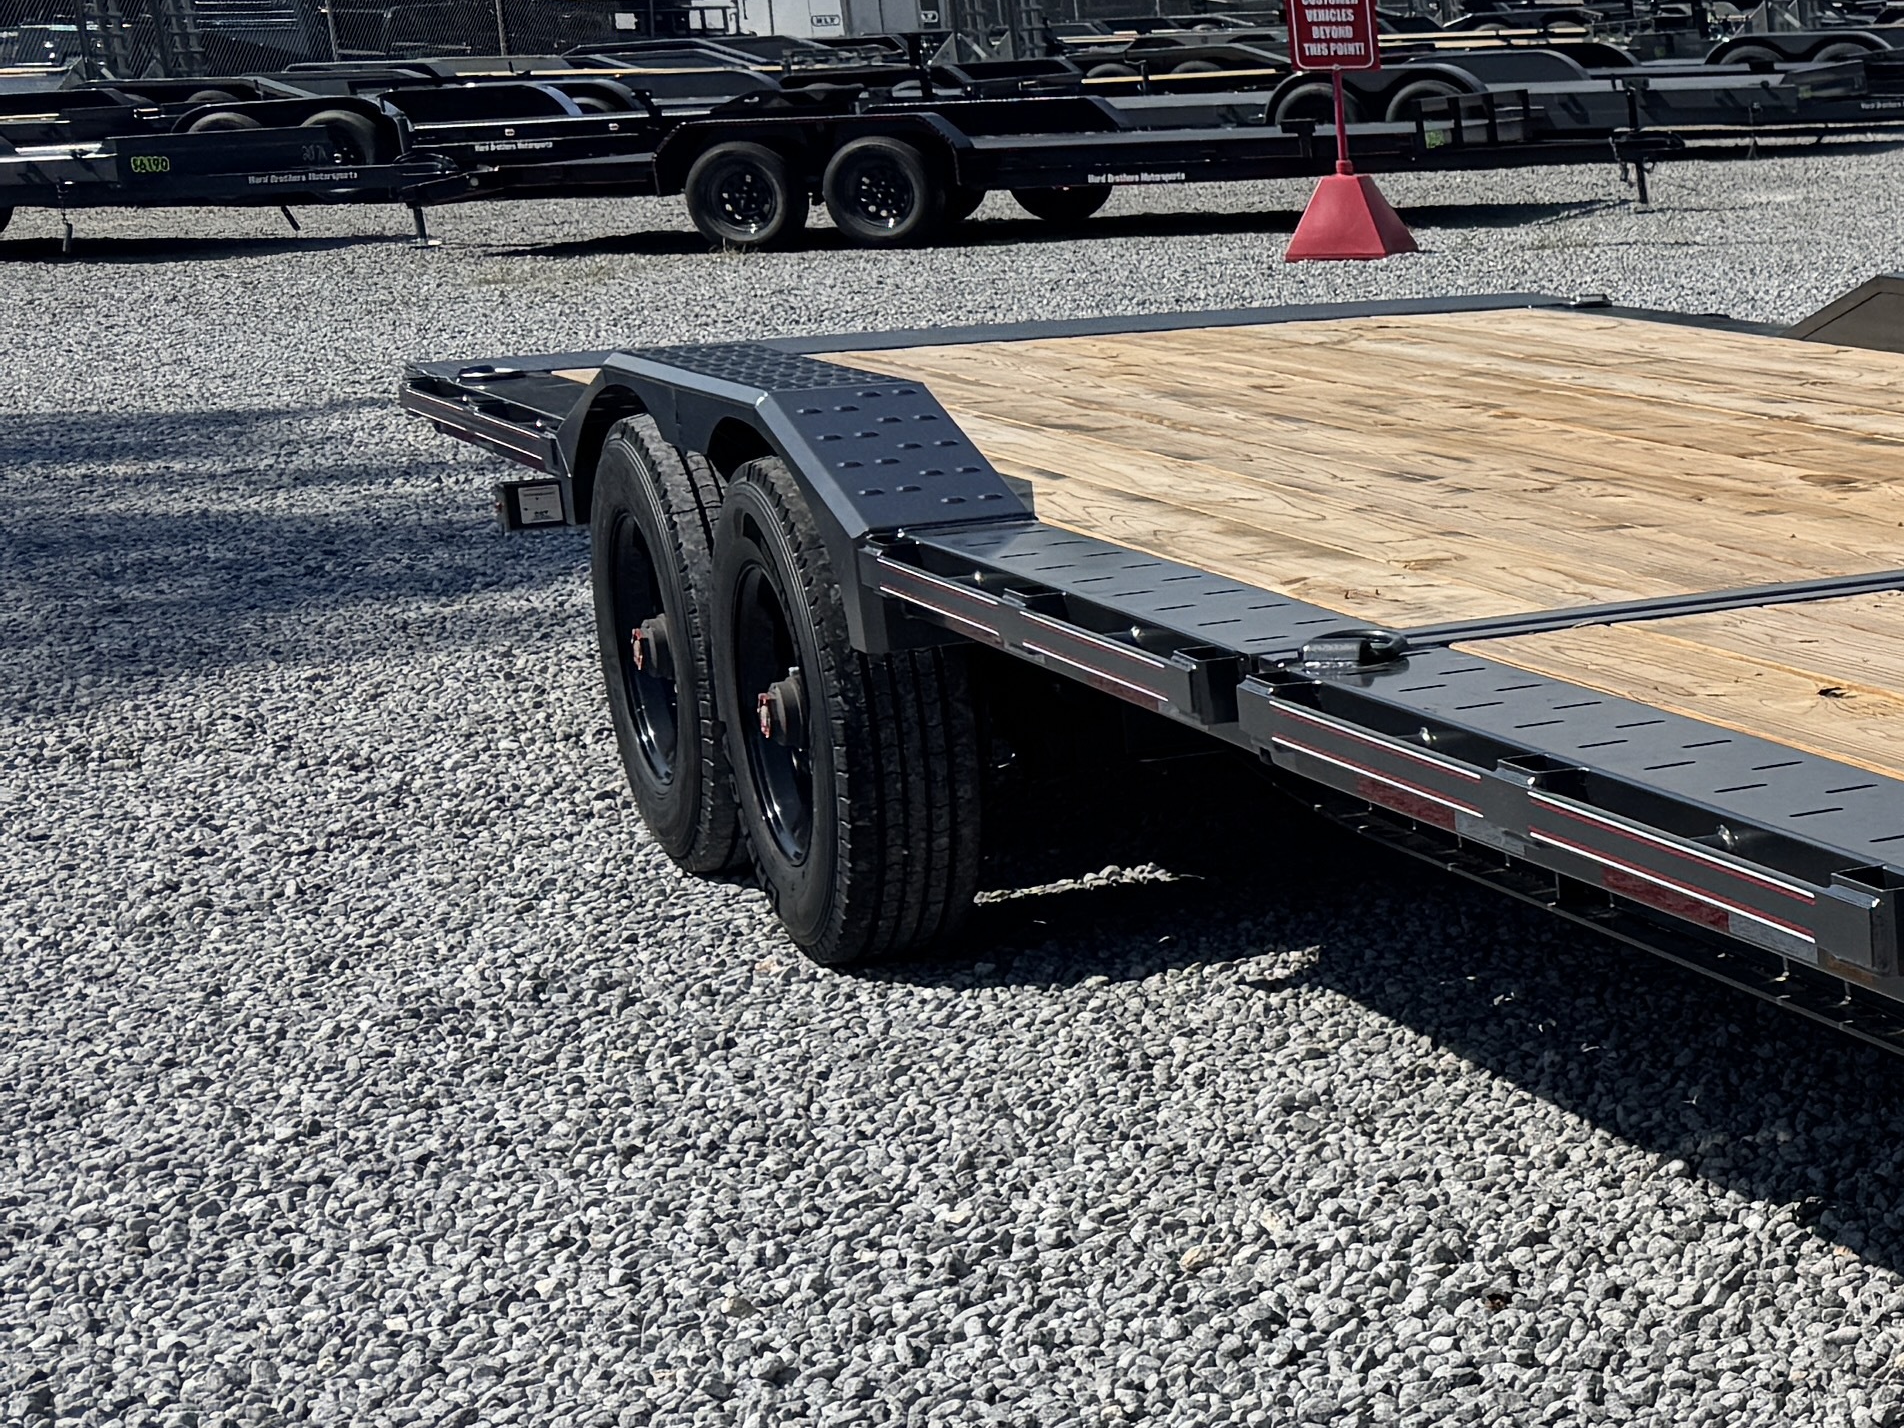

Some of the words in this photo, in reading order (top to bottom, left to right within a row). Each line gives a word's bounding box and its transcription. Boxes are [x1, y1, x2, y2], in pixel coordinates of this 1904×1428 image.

[1305, 9, 1355, 22] VEHICLES
[1312, 25, 1353, 39] BEYOND
[1303, 43, 1328, 56] THIS
